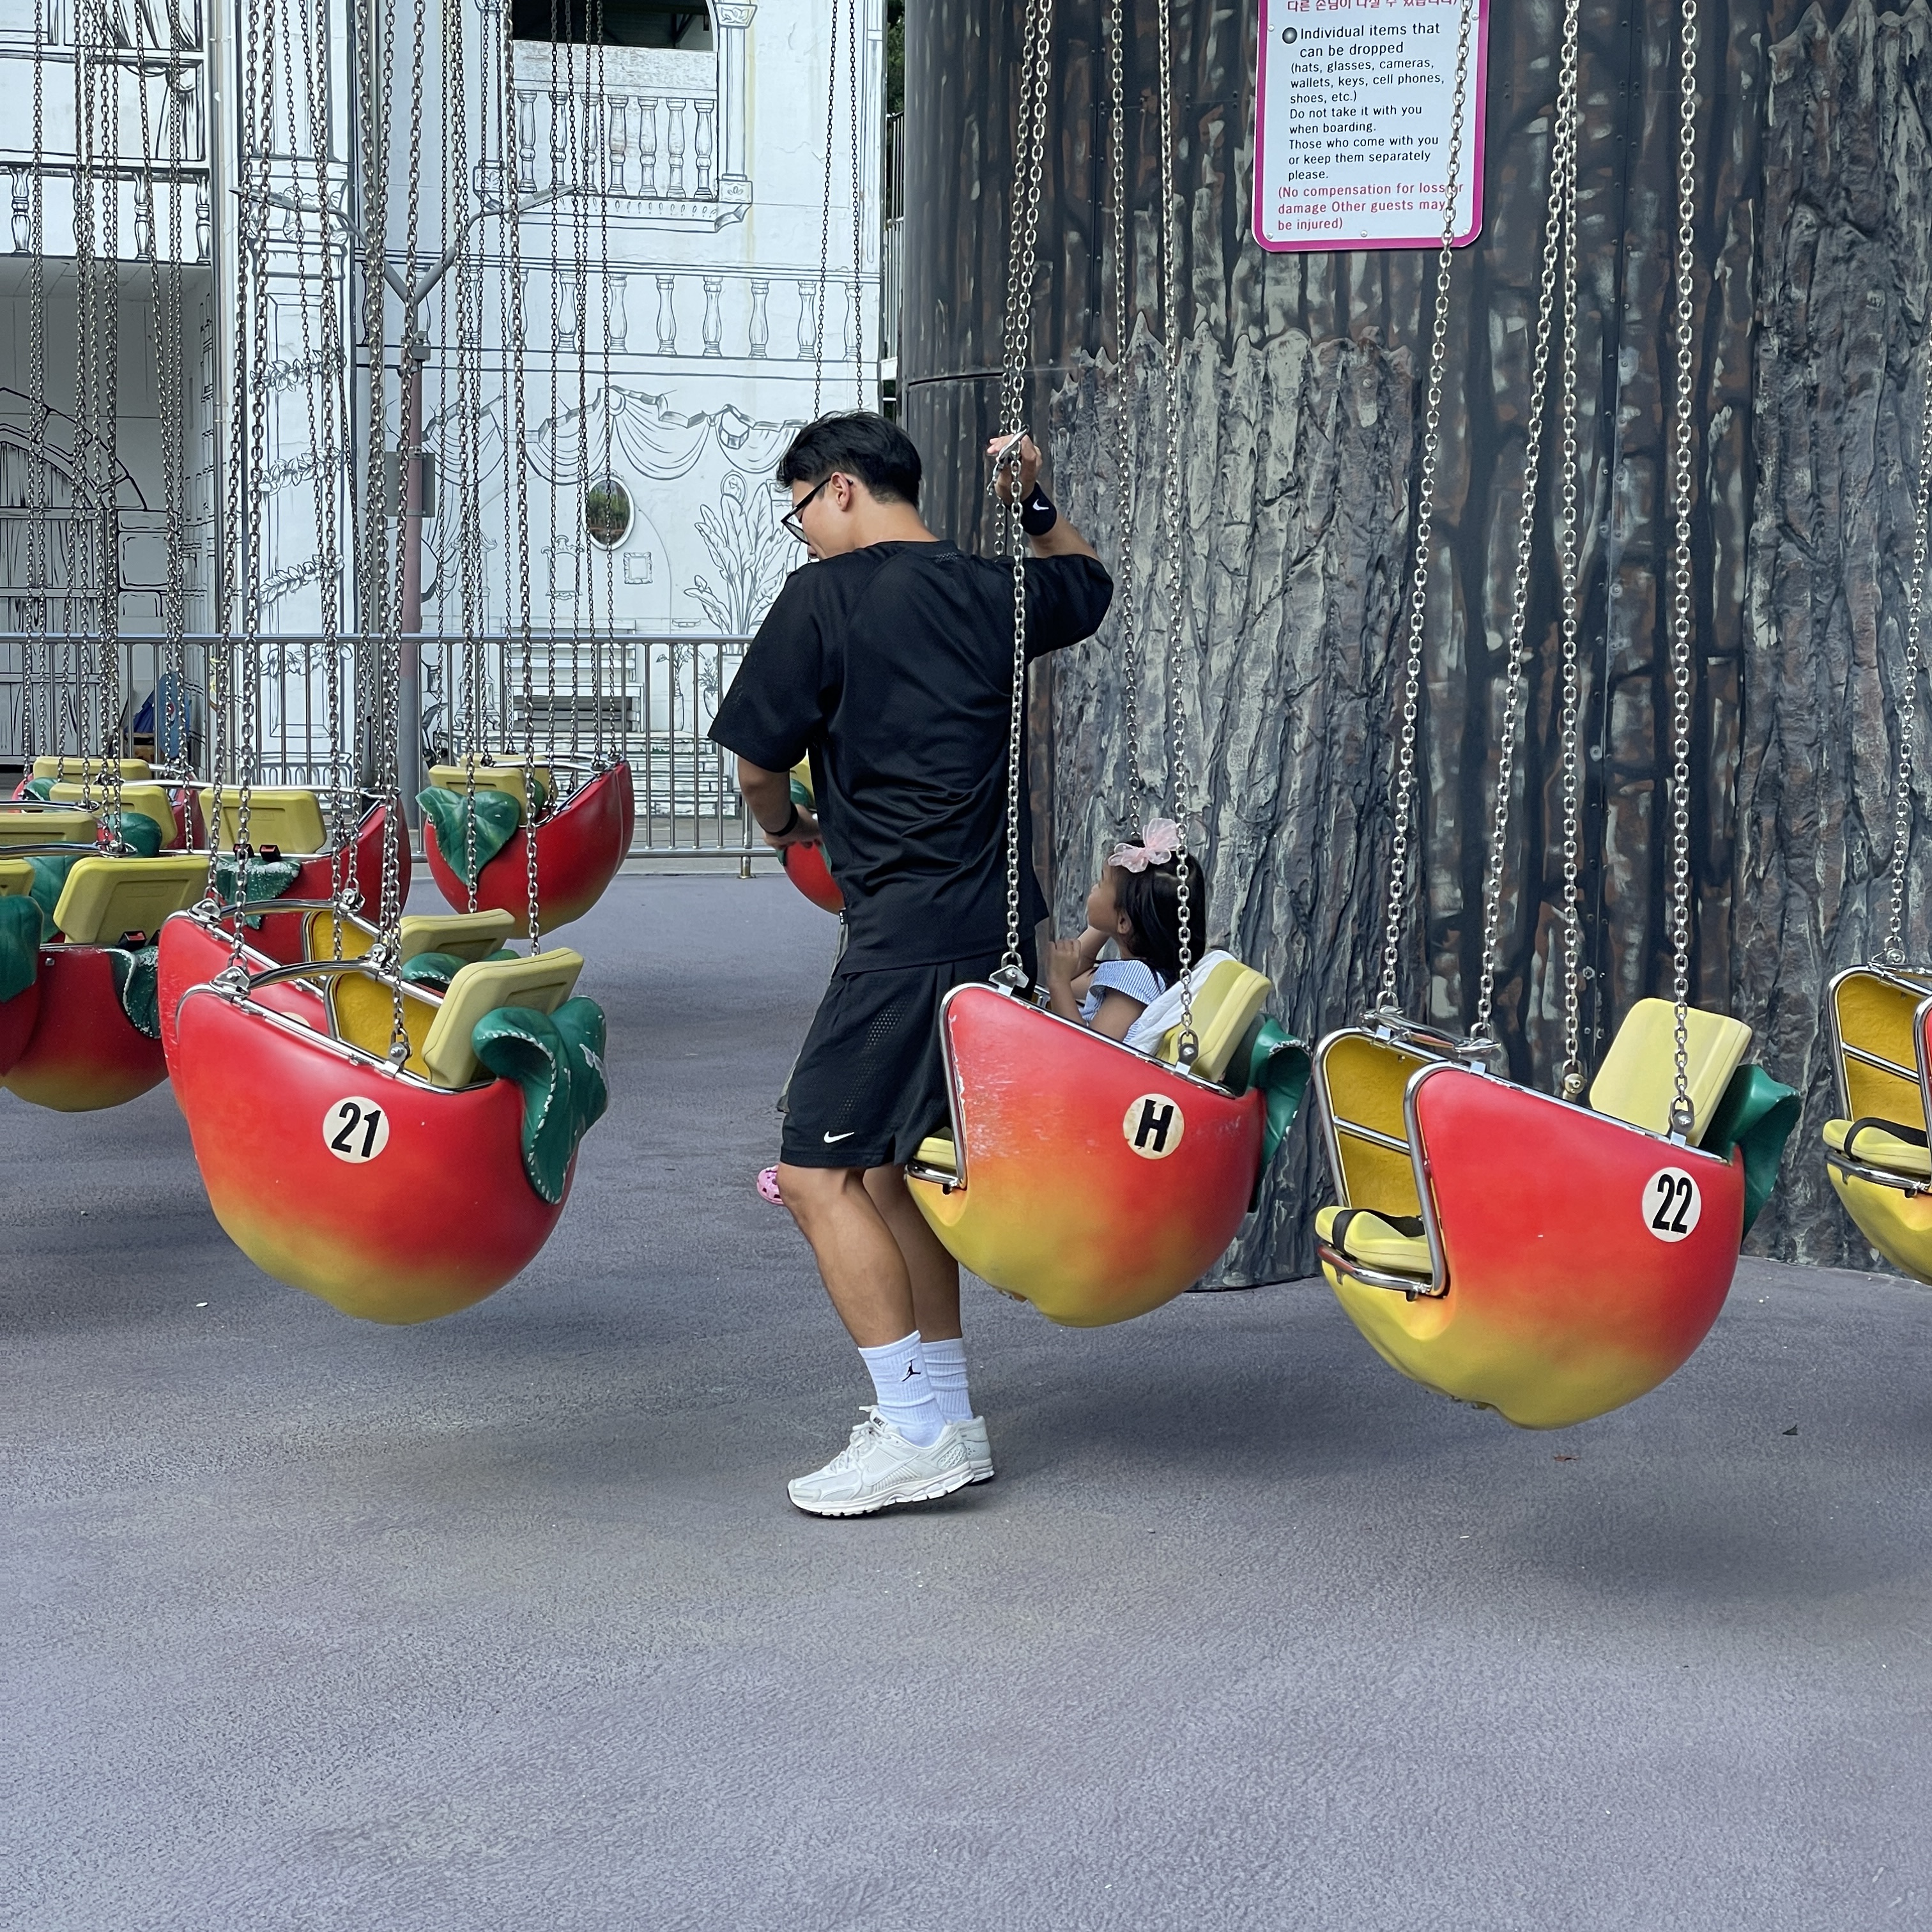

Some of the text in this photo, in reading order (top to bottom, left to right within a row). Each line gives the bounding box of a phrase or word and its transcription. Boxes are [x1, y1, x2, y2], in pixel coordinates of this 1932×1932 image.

[1287, 0, 1310, 12] 다른
[1301, 22, 1440, 40] Individual items that
[1300, 42, 1403, 57] can be dropped
[1291, 59, 1434, 74] (hats, glasses, cameras,
[1291, 73, 1444, 88] wallets, keys, cell phones,
[1291, 90, 1356, 104] shoes, etc.)
[1291, 105, 1422, 119] Do not take it with you
[1289, 121, 1376, 134] when boarding.
[1289, 135, 1438, 150] Those who come with you
[1304, 155, 1330, 165] keep
[1335, 153, 1363, 163] them
[1369, 150, 1430, 163] separately
[1289, 170, 1328, 181] please.
[1279, 187, 1298, 199] (No
[1303, 184, 1390, 197] compensation
[1397, 183, 1414, 194] for
[1420, 183, 1445, 193] loss
[1278, 200, 1445, 215] damage Other guests may
[1278, 217, 1342, 231] be injured)
[331, 1102, 381, 1158] 21
[1134, 1099, 1174, 1153] H
[1652, 1174, 1692, 1234] 22
